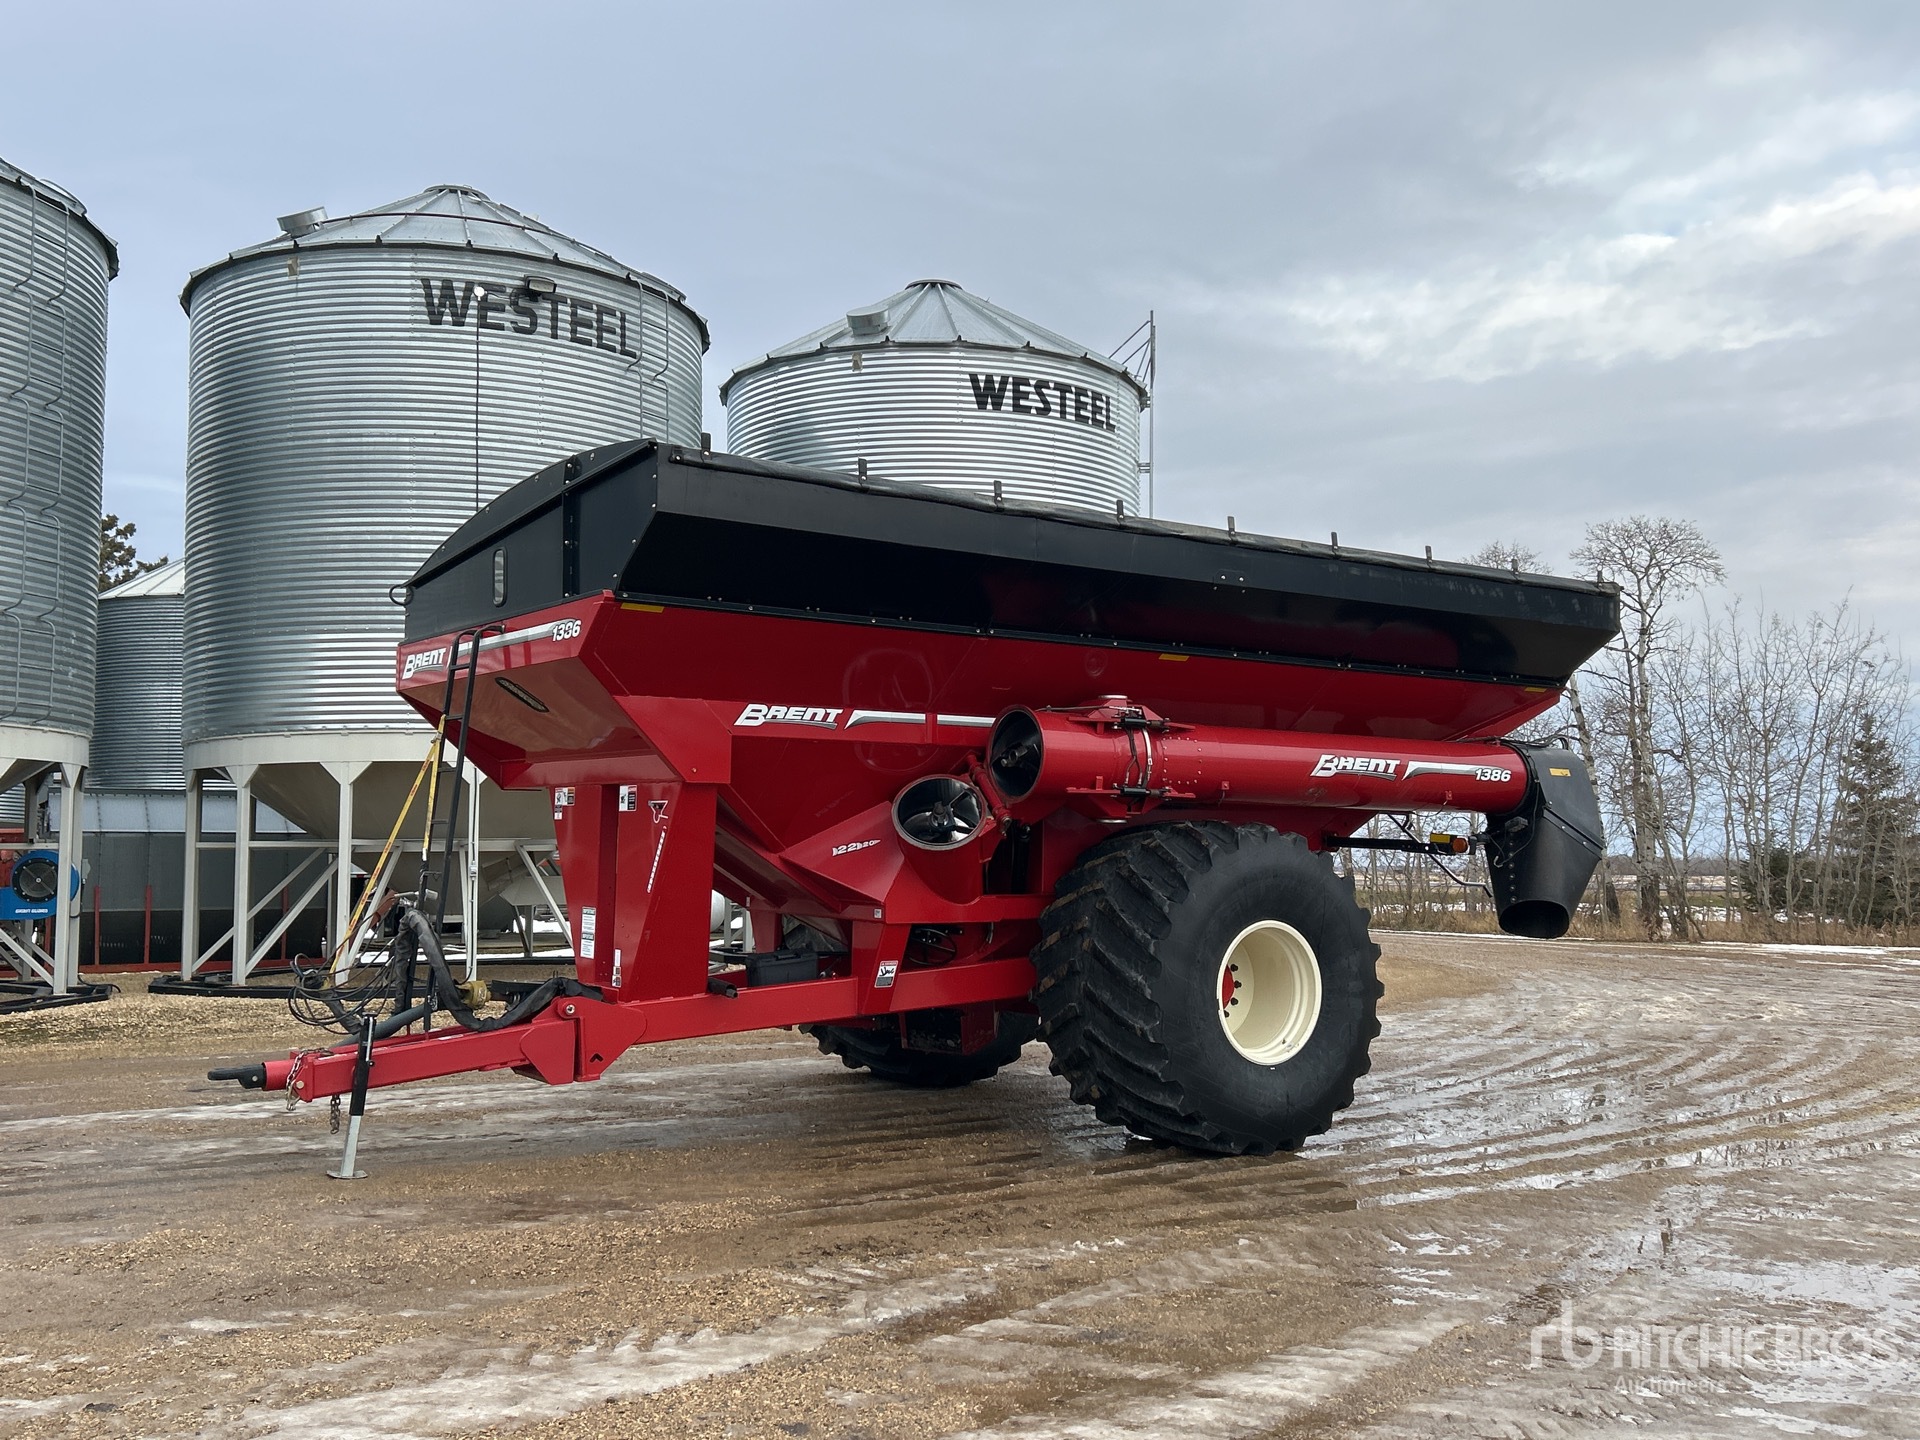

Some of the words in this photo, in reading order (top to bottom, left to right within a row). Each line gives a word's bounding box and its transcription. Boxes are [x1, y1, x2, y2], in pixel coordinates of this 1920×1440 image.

[420, 278, 637, 359] WESTEEL
[968, 373, 1116, 432] WESTEEL
[402, 647, 447, 680] BRENT
[552, 619, 582, 641] 1386
[733, 703, 844, 727] BRENT
[1310, 754, 1401, 777] BRENT
[1475, 768, 1511, 782] 1386
